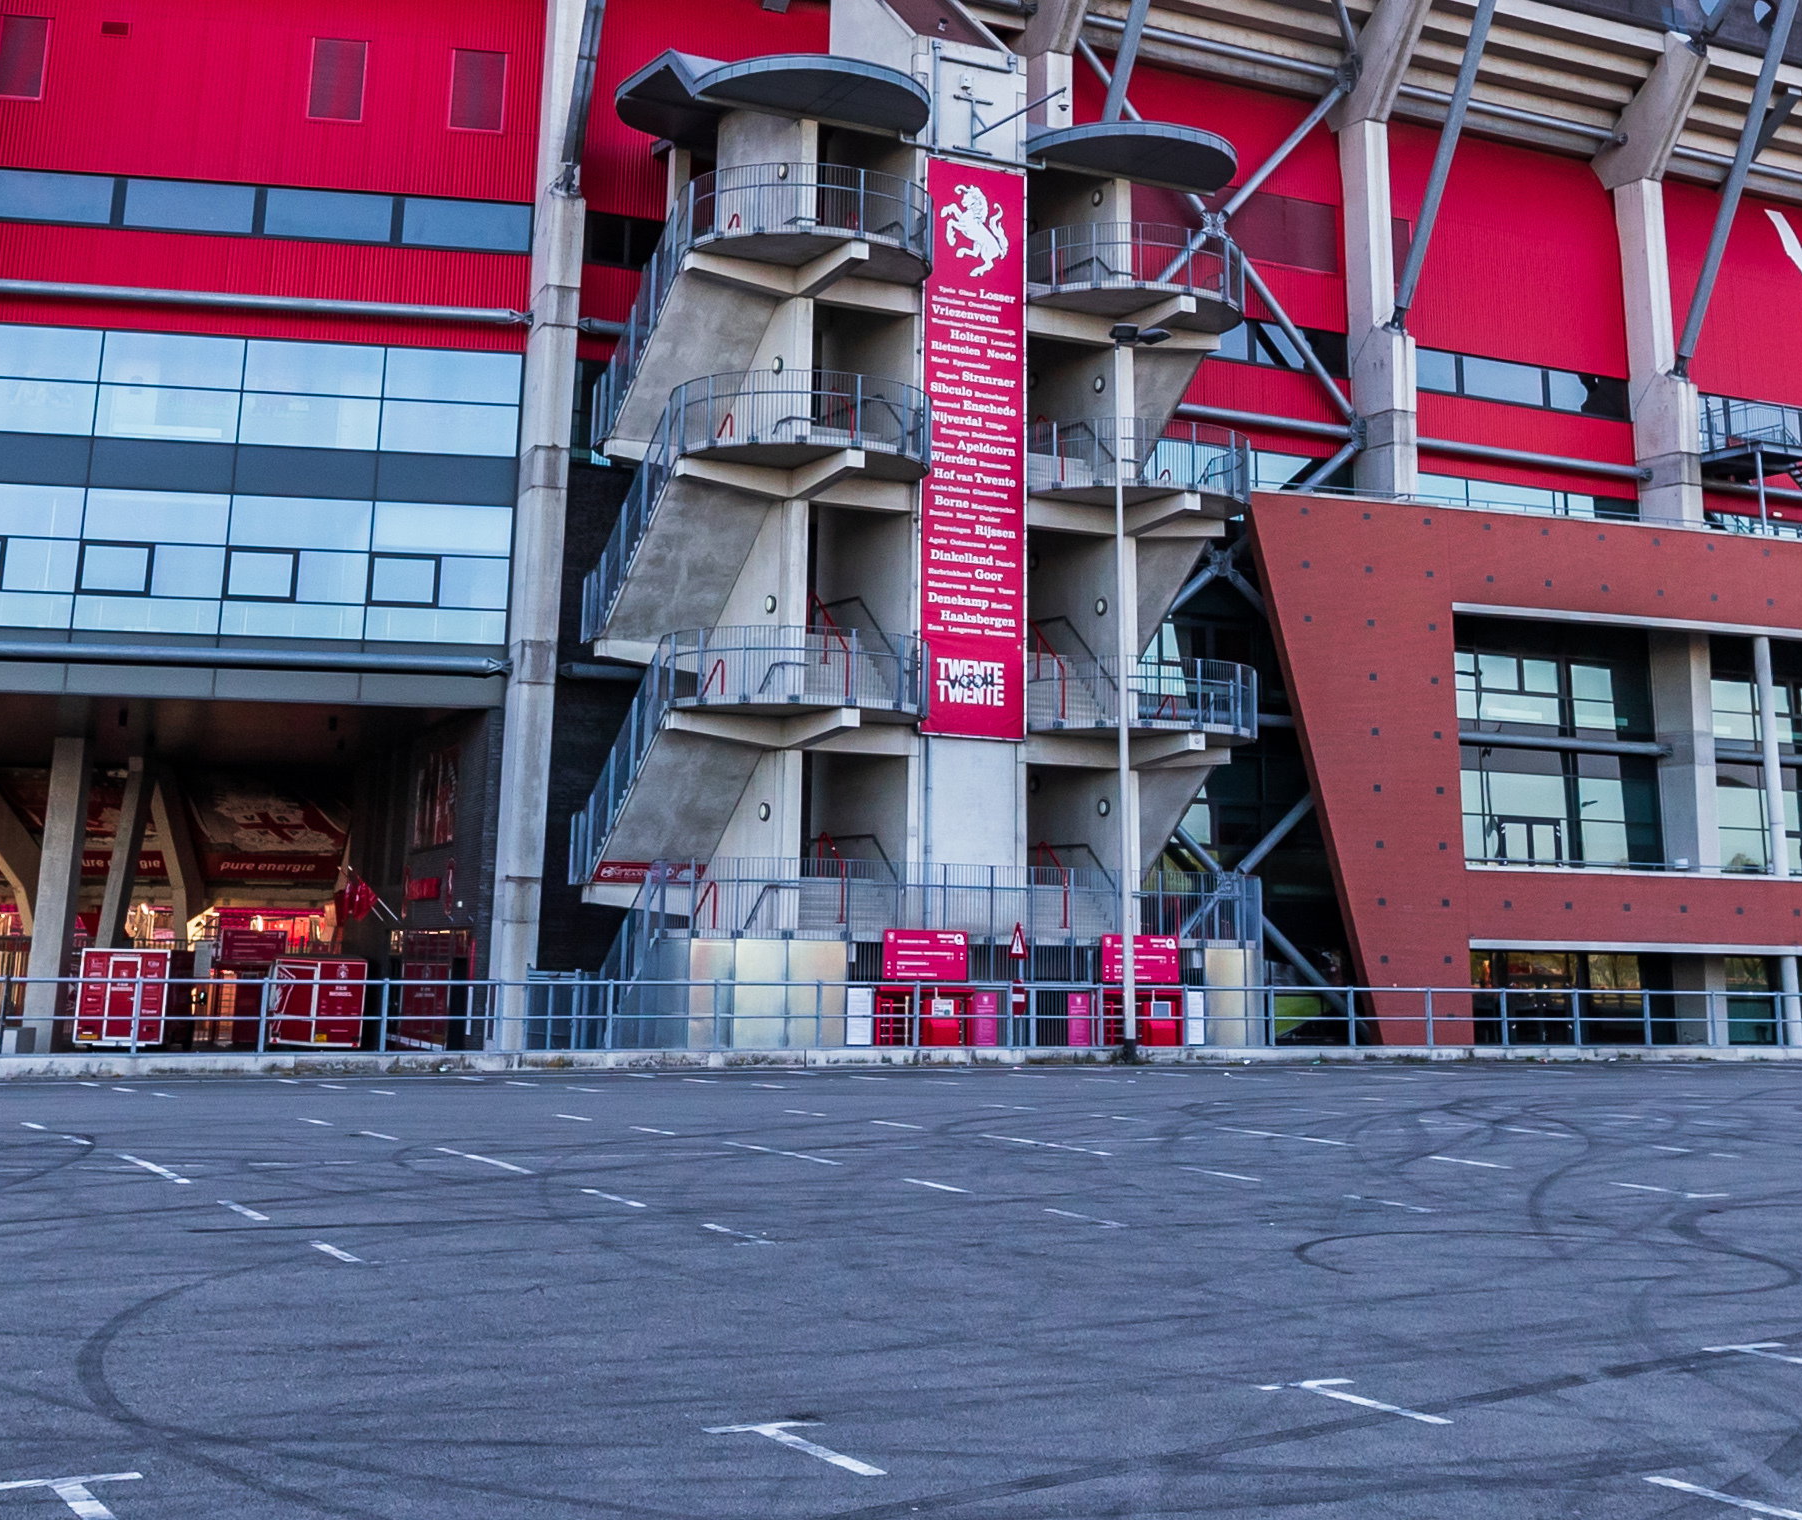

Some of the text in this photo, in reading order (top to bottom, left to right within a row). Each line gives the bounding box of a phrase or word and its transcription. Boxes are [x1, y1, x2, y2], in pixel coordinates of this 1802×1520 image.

[979, 288, 1016, 304] Losser
[931, 303, 999, 324] Vriezenveen
[950, 328, 988, 344] Holten
[931, 340, 1017, 362] Rietmolen Neede
[961, 370, 1016, 388] Stranraer
[930, 381, 973, 397] Sibculo
[962, 399, 1017, 417] Enschede
[930, 410, 983, 427] Nijverdal
[956, 440, 1016, 457] Apeldoorn
[930, 450, 978, 466] Wierden
[933, 467, 1016, 488] Hof van Twente
[934, 494, 970, 509] Borne
[974, 524, 1016, 539] Rijssen
[930, 548, 994, 566] Dinkelland
[974, 568, 1004, 581] Goor
[927, 591, 990, 610] Denekamp
[940, 609, 1016, 628] Haaksbergen
[936, 657, 1005, 684] TWENTE
[936, 679, 1005, 707] TWENTE
[220, 861, 316, 873] pure energie
